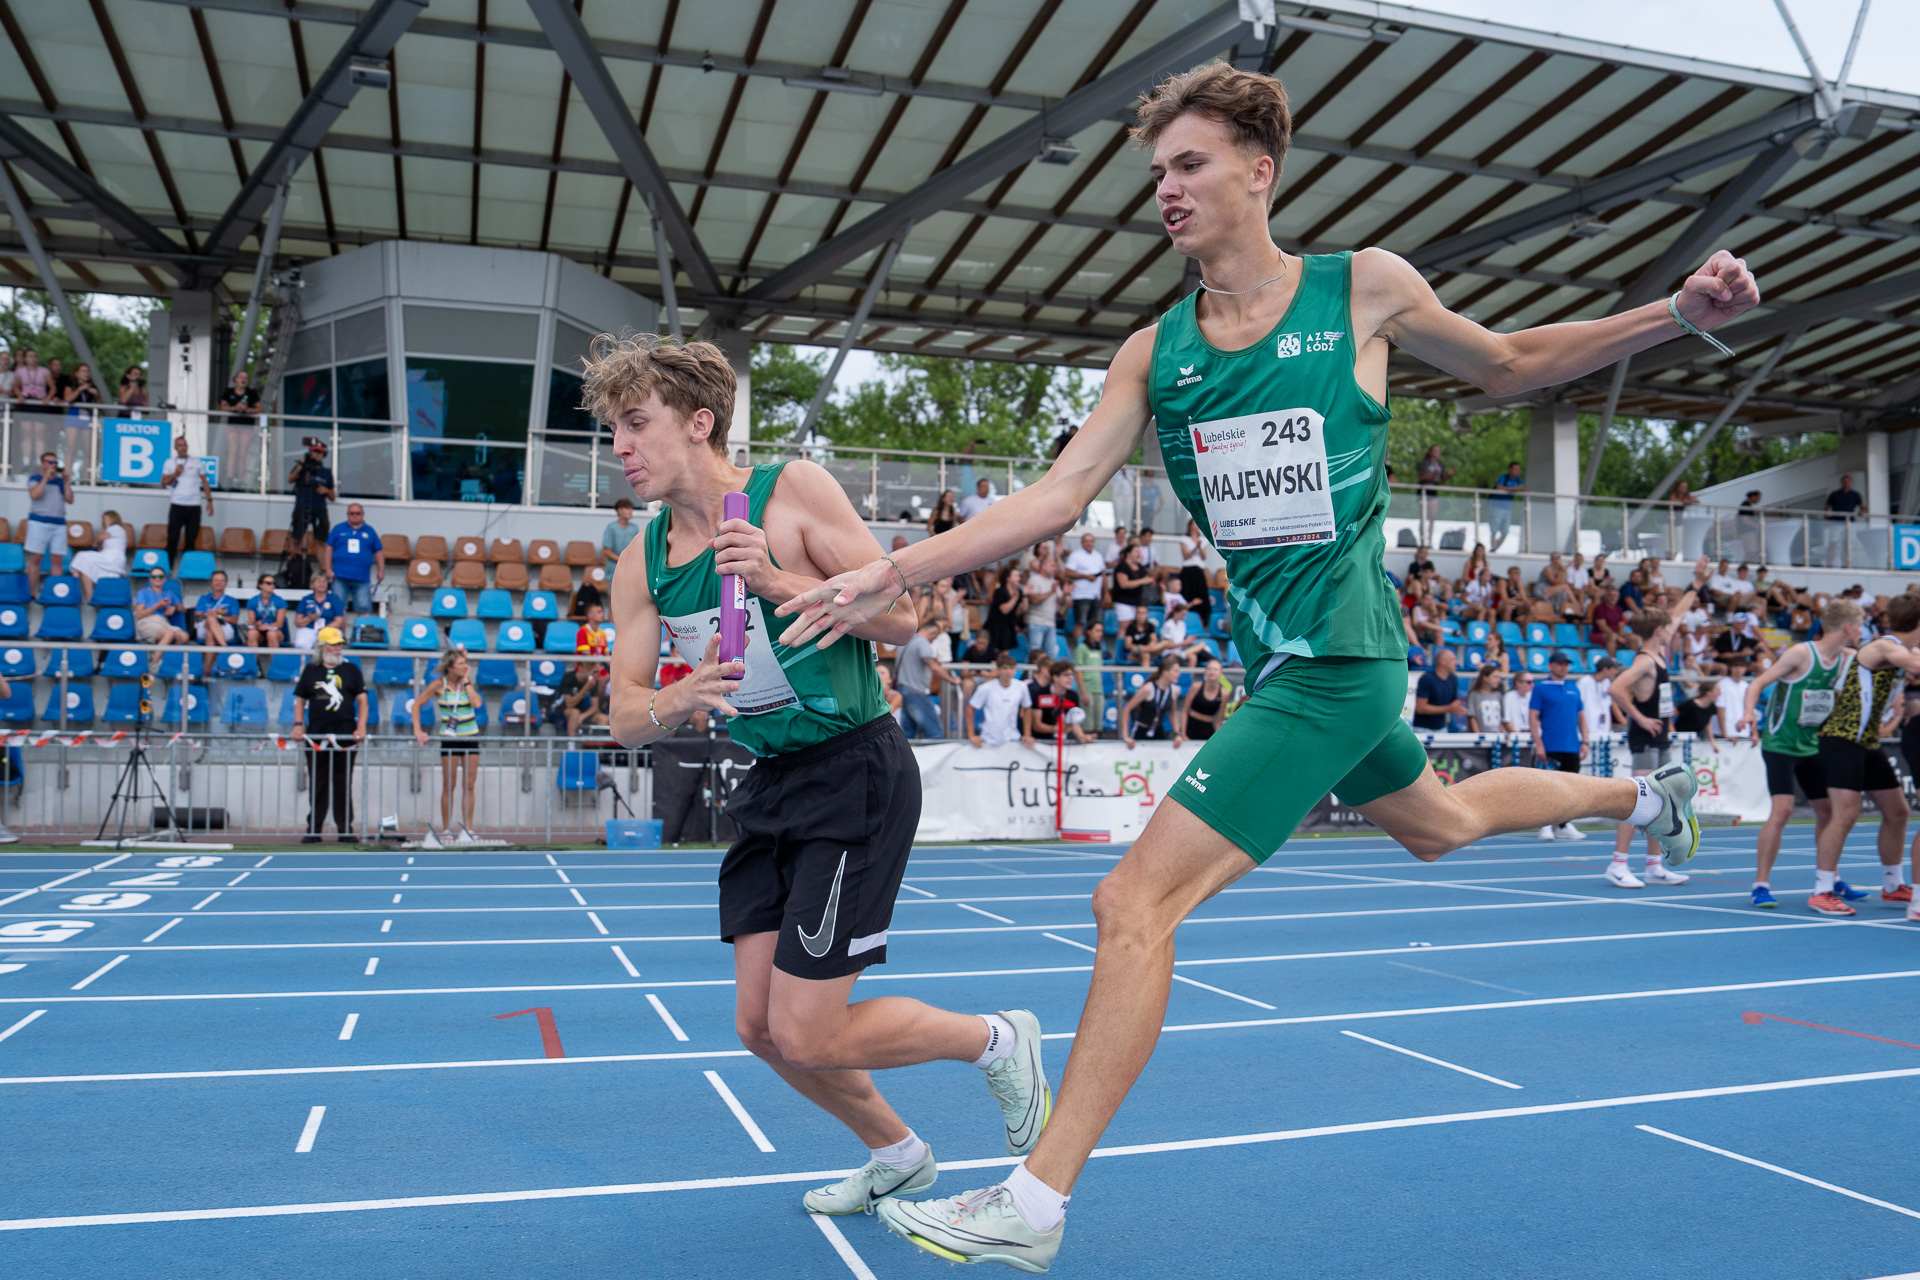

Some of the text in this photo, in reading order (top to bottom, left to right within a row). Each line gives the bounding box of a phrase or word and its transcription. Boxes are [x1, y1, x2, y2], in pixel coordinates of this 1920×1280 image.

[1306, 339, 1335, 352] ŁÓDŹ
[1177, 374, 1203, 387] erima
[116, 423, 160, 435] SEKTOR
[1261, 415, 1312, 447] 243
[119, 436, 154, 478] B
[1202, 462, 1323, 503] MAJEWSKI
[1219, 517, 1257, 528] LUBELSKIE
[1279, 523, 1308, 531] Mistrzostwa
[1308, 521, 1323, 529] Polski
[1221, 529, 1236, 537] 2024
[1277, 533, 1321, 544] 5-7.07.2024
[1901, 536, 1920, 566] D
[709, 609, 755, 634] 22
[1185, 775, 1207, 793] erima
